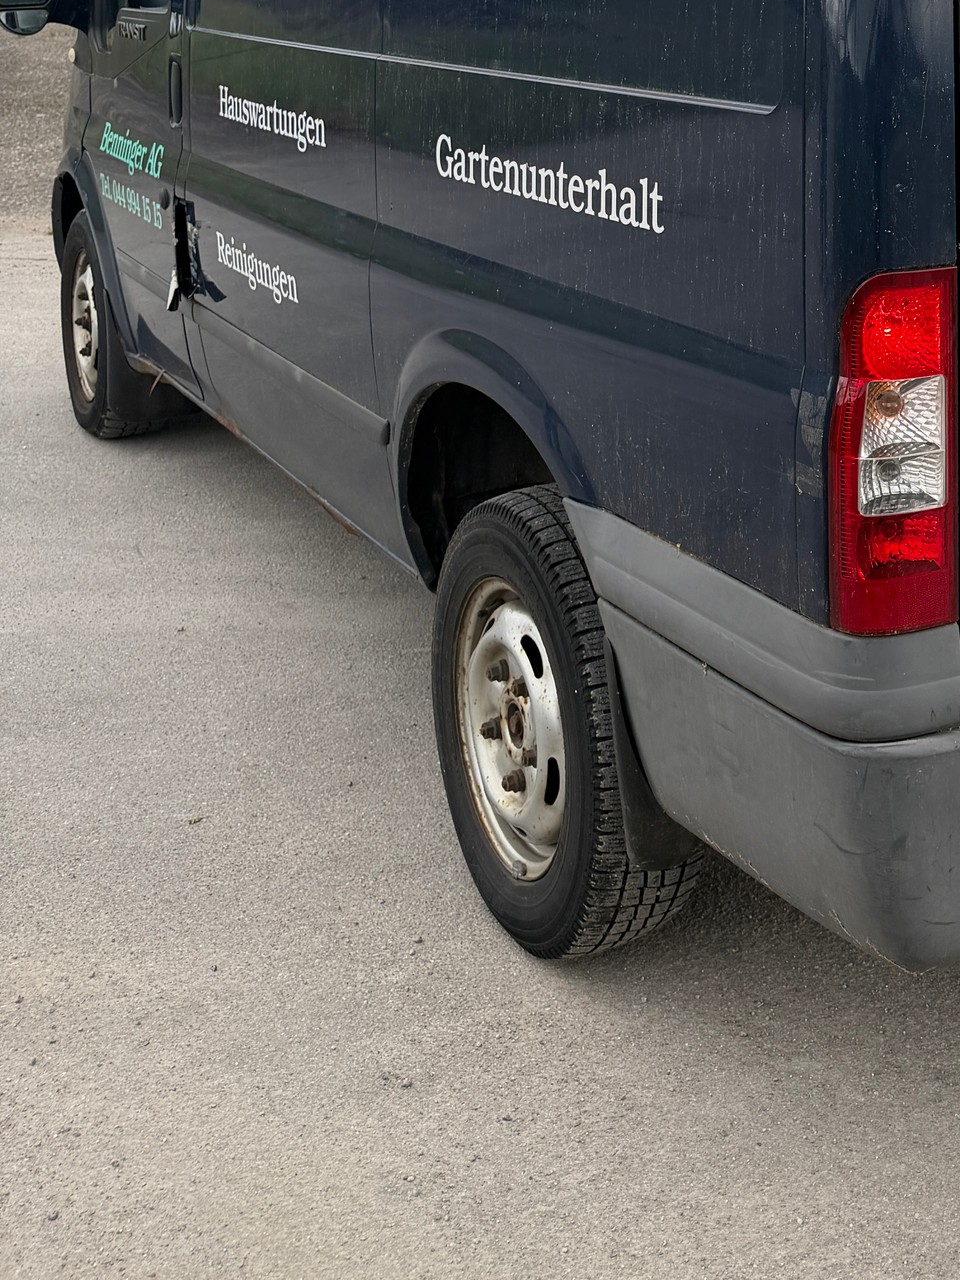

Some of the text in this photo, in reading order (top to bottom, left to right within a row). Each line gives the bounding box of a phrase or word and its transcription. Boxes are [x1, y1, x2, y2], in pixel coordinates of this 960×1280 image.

[99, 121, 164, 179] Benninger AG
[218, 85, 327, 153] Hauswartungen
[100, 172, 163, 230] Tel. 044 994 15 15
[434, 133, 666, 235] Gartenunterhalt
[215, 230, 299, 305] Reinigungen
